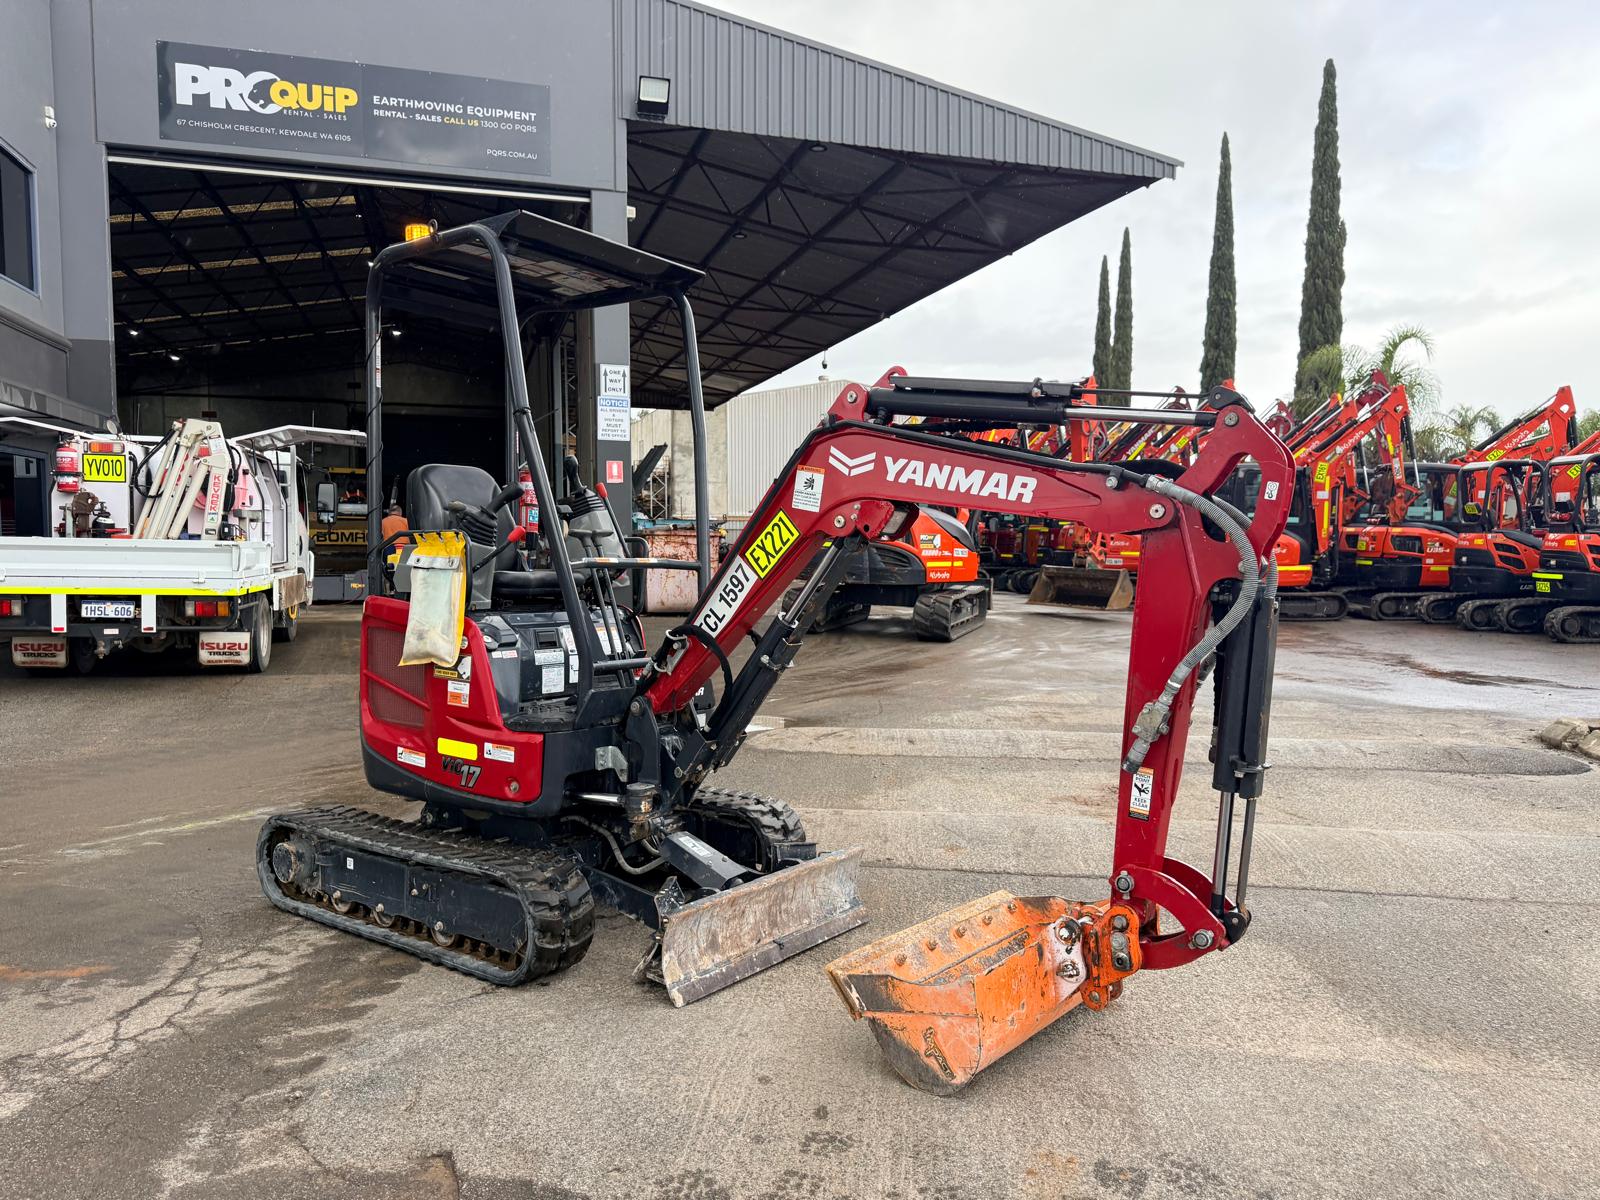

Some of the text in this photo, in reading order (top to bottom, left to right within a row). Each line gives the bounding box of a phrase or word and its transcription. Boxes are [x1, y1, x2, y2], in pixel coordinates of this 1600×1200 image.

[283, 109, 313, 118] RENTAL
[324, 113, 347, 121] SALES
[373, 96, 537, 122] EARTHMOVING EQUIPMENT
[188, 120, 232, 130] CHISHOLM
[234, 124, 278, 135] CRESCENT,
[279, 129, 318, 139] KEWDALE
[334, 134, 352, 142] 6105
[374, 109, 407, 119] RENTAL
[415, 113, 442, 122] SALES
[444, 116, 465, 125] CALL
[480, 120, 498, 129] 1300
[515, 124, 537, 133] PQRS
[486, 148, 538, 160] PQRS.COM.AU
[600, 399, 628, 407] NOTICE
[1504, 429, 1530, 450] Kubota
[86, 458, 122, 477] YV010
[884, 456, 1038, 504] YANMAR
[210, 474, 222, 512] KEVREK
[316, 532, 367, 543] BOMA
[750, 516, 794, 572] EX221
[718, 563, 750, 608] 1597
[14, 643, 64, 652] ISUZU
[200, 640, 248, 650] ISUZU
